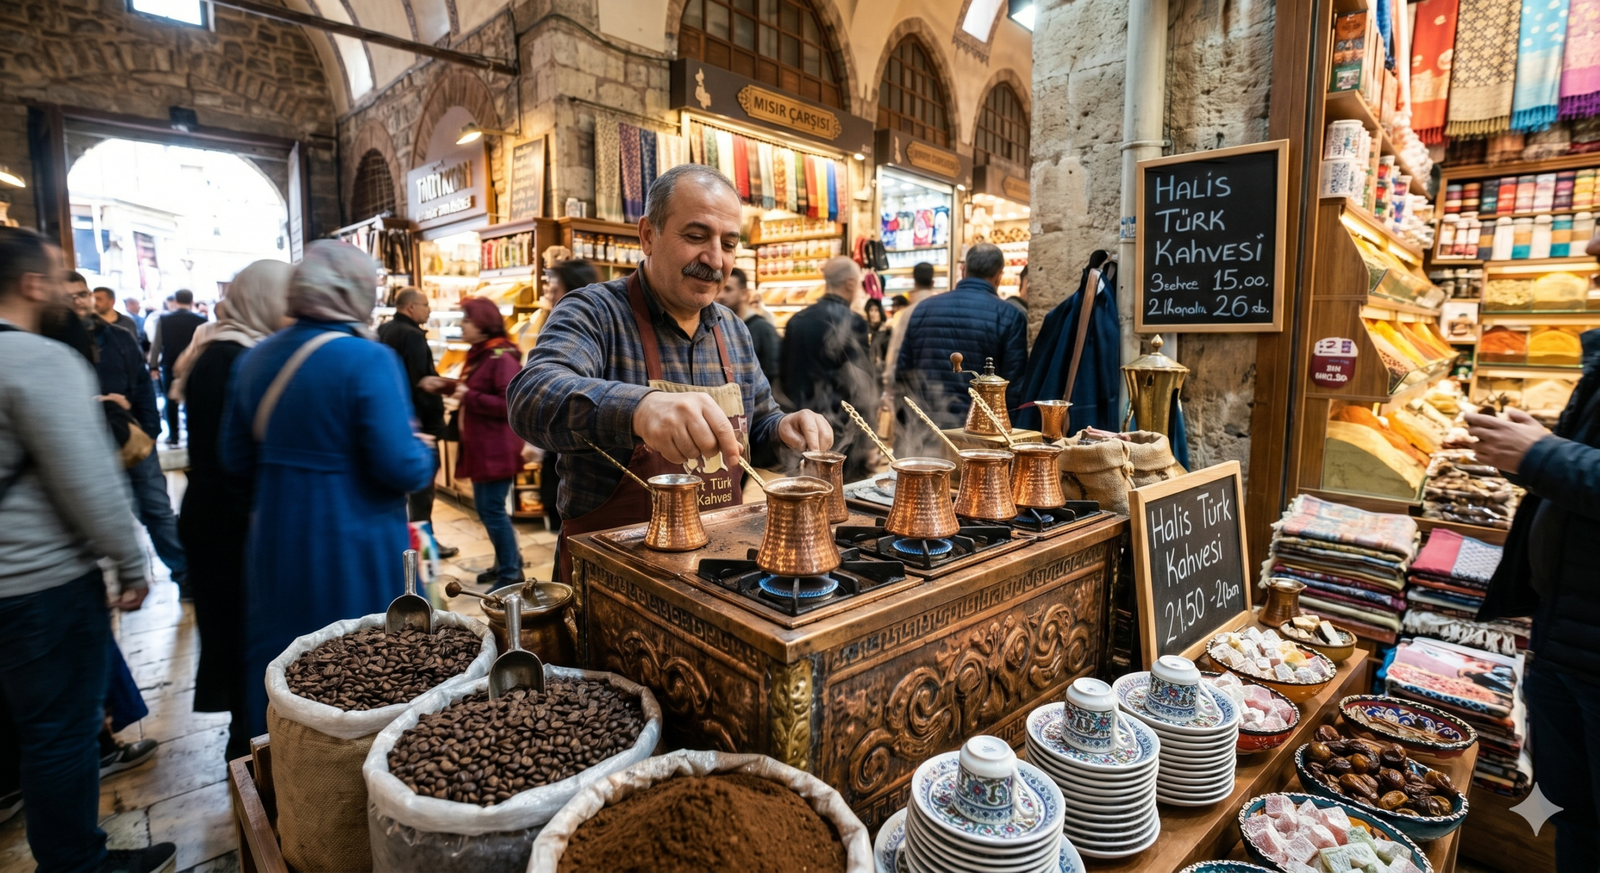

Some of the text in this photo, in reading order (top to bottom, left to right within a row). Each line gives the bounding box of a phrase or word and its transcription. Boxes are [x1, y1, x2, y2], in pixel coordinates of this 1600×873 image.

[754, 96, 830, 131] MISIR ÇARŞISI
[1155, 208, 1226, 233] TÜRK
[1212, 295, 1249, 318] 26
[710, 476, 732, 490] Türk
[697, 490, 732, 506] Kahvesi
[1151, 488, 1232, 549] Halis Türk
[1166, 533, 1223, 588] Kahvesi
